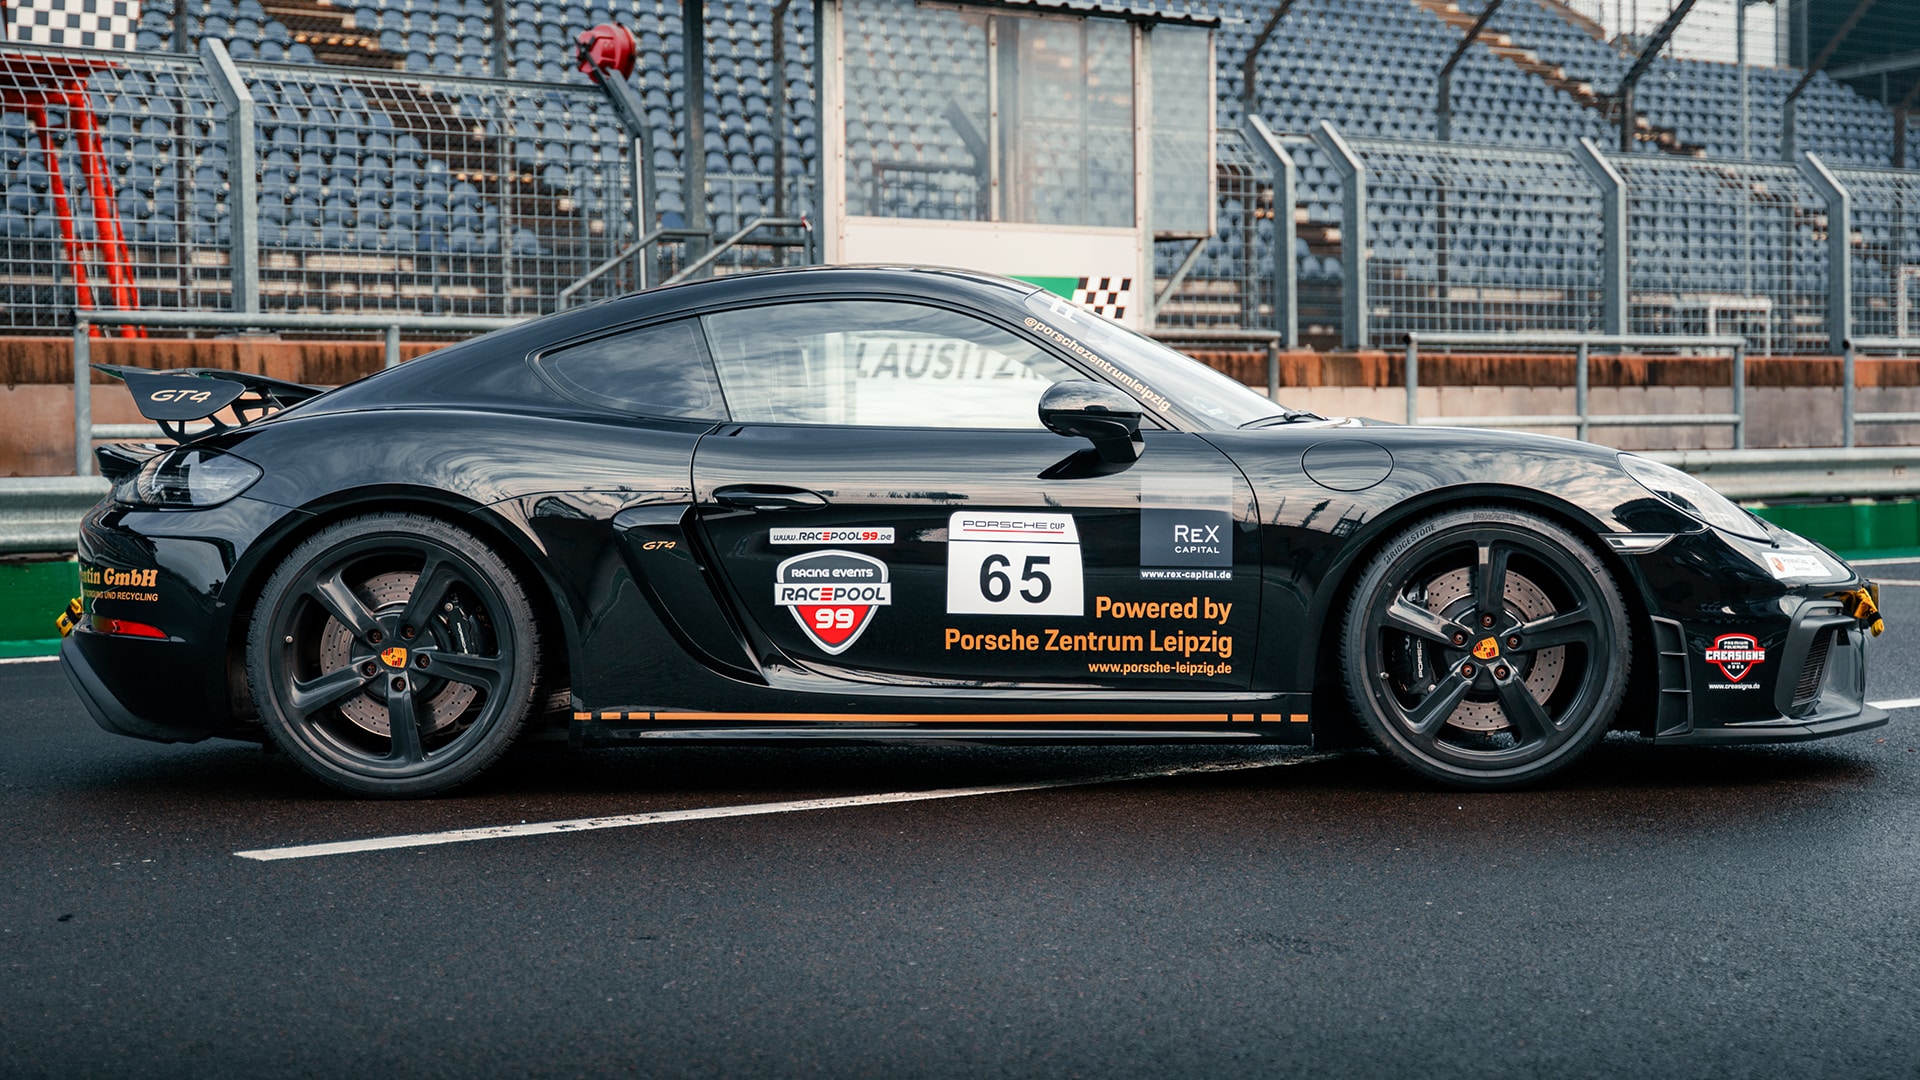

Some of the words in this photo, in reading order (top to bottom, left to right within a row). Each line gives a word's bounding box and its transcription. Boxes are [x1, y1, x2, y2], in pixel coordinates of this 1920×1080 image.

[1024, 317, 1171, 412] @porschezentrumleipzig
[150, 389, 212, 404] GT4
[962, 520, 1048, 530] PORSCHE
[1049, 522, 1066, 530] CUP
[642, 541, 677, 551] GT4
[1174, 545, 1221, 554] CAPITAL
[1383, 521, 1437, 565] BRIDGESTONE
[103, 567, 159, 588] GmbH
[979, 553, 1052, 604] 65
[1141, 570, 1232, 580] www.rex-capital.de
[117, 592, 159, 602] RECYCLING
[781, 587, 886, 601] RACEPOOL
[1096, 596, 1198, 619] Powered
[1203, 597, 1233, 625] by
[815, 608, 855, 629] 99
[945, 628, 1039, 651] Porsche
[1044, 629, 1144, 651] Zentrum
[1149, 630, 1233, 658] Leipzig
[1705, 650, 1765, 661] CREASIGNS
[1088, 661, 1232, 676] www.porsche-leipzig.de
[1708, 682, 1761, 691] www.creasigns.de
